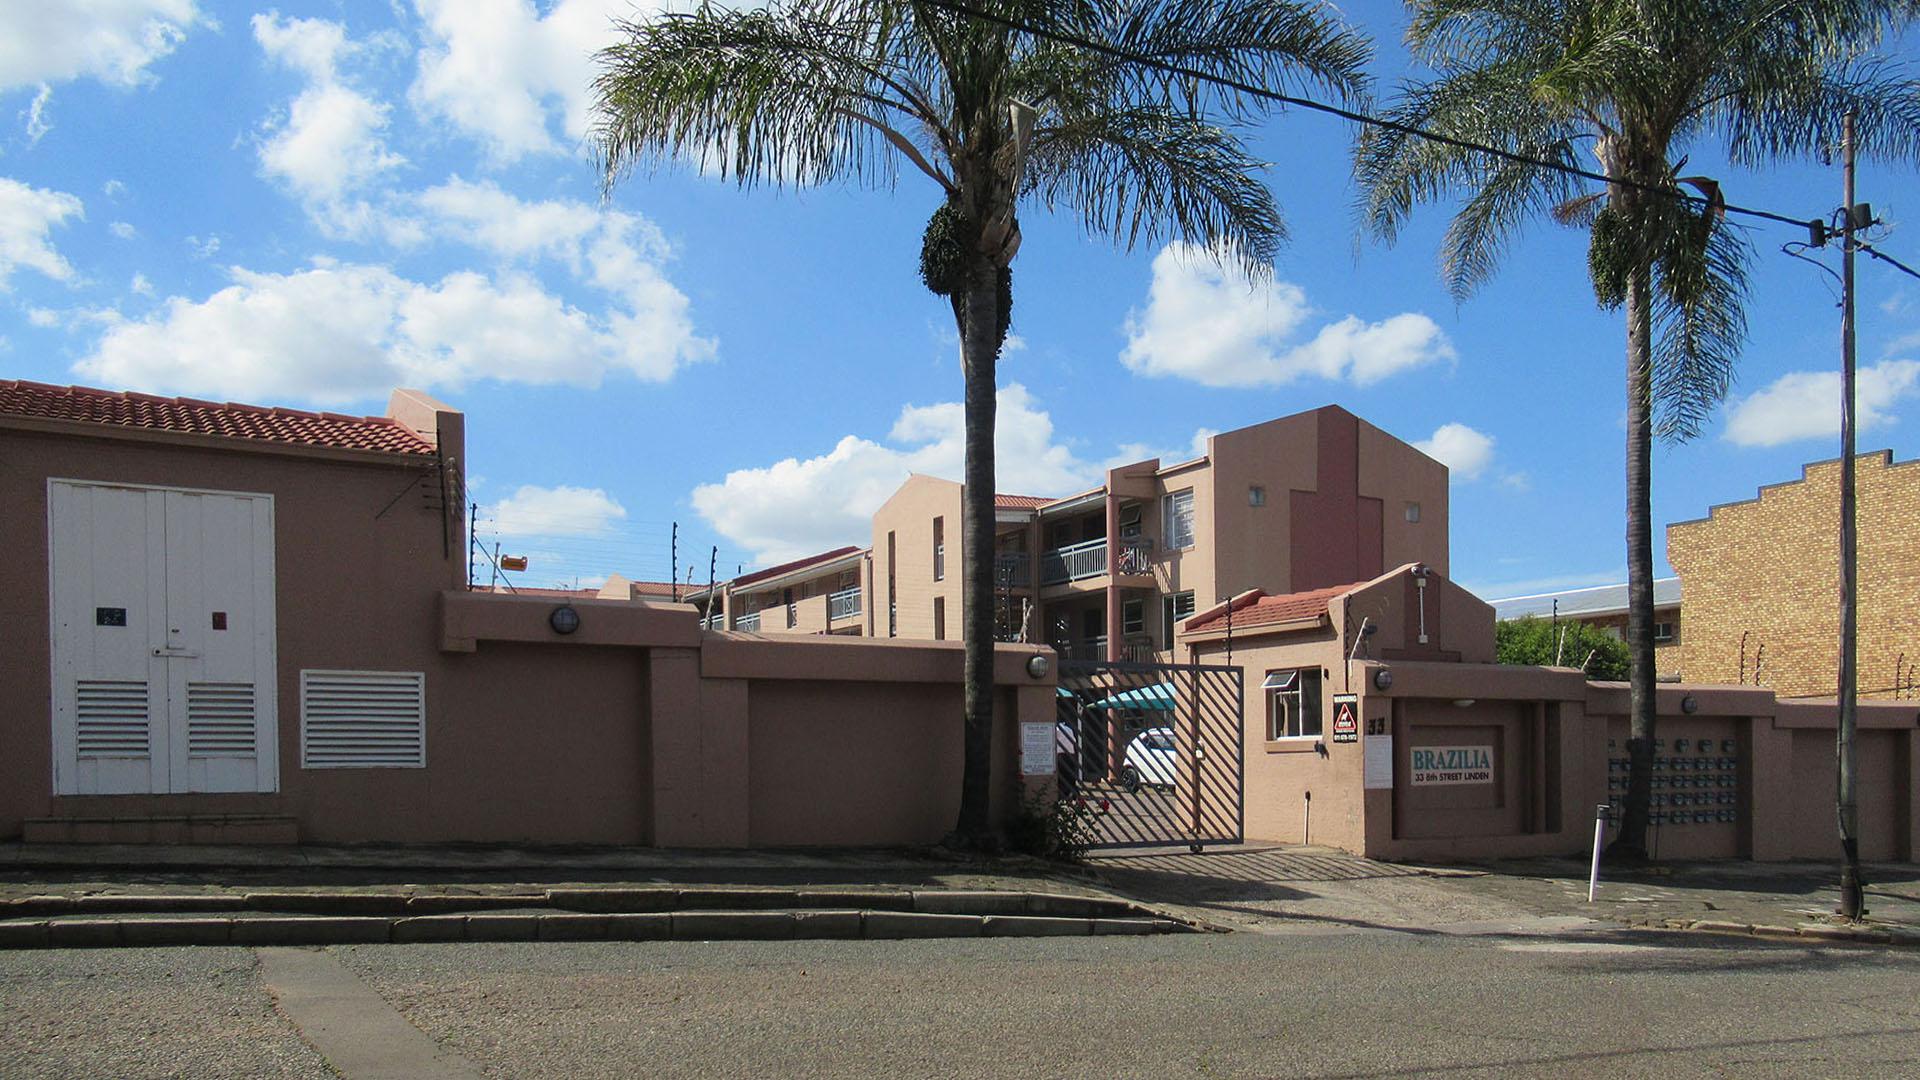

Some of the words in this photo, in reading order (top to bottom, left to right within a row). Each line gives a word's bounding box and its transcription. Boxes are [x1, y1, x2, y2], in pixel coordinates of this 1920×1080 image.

[1369, 717, 1385, 735] 33
[1413, 750, 1490, 769] BRAZILIA
[1415, 774, 1424, 782] 33
[1440, 772, 1462, 781] STREET
[1465, 771, 1489, 780] LINDEN
